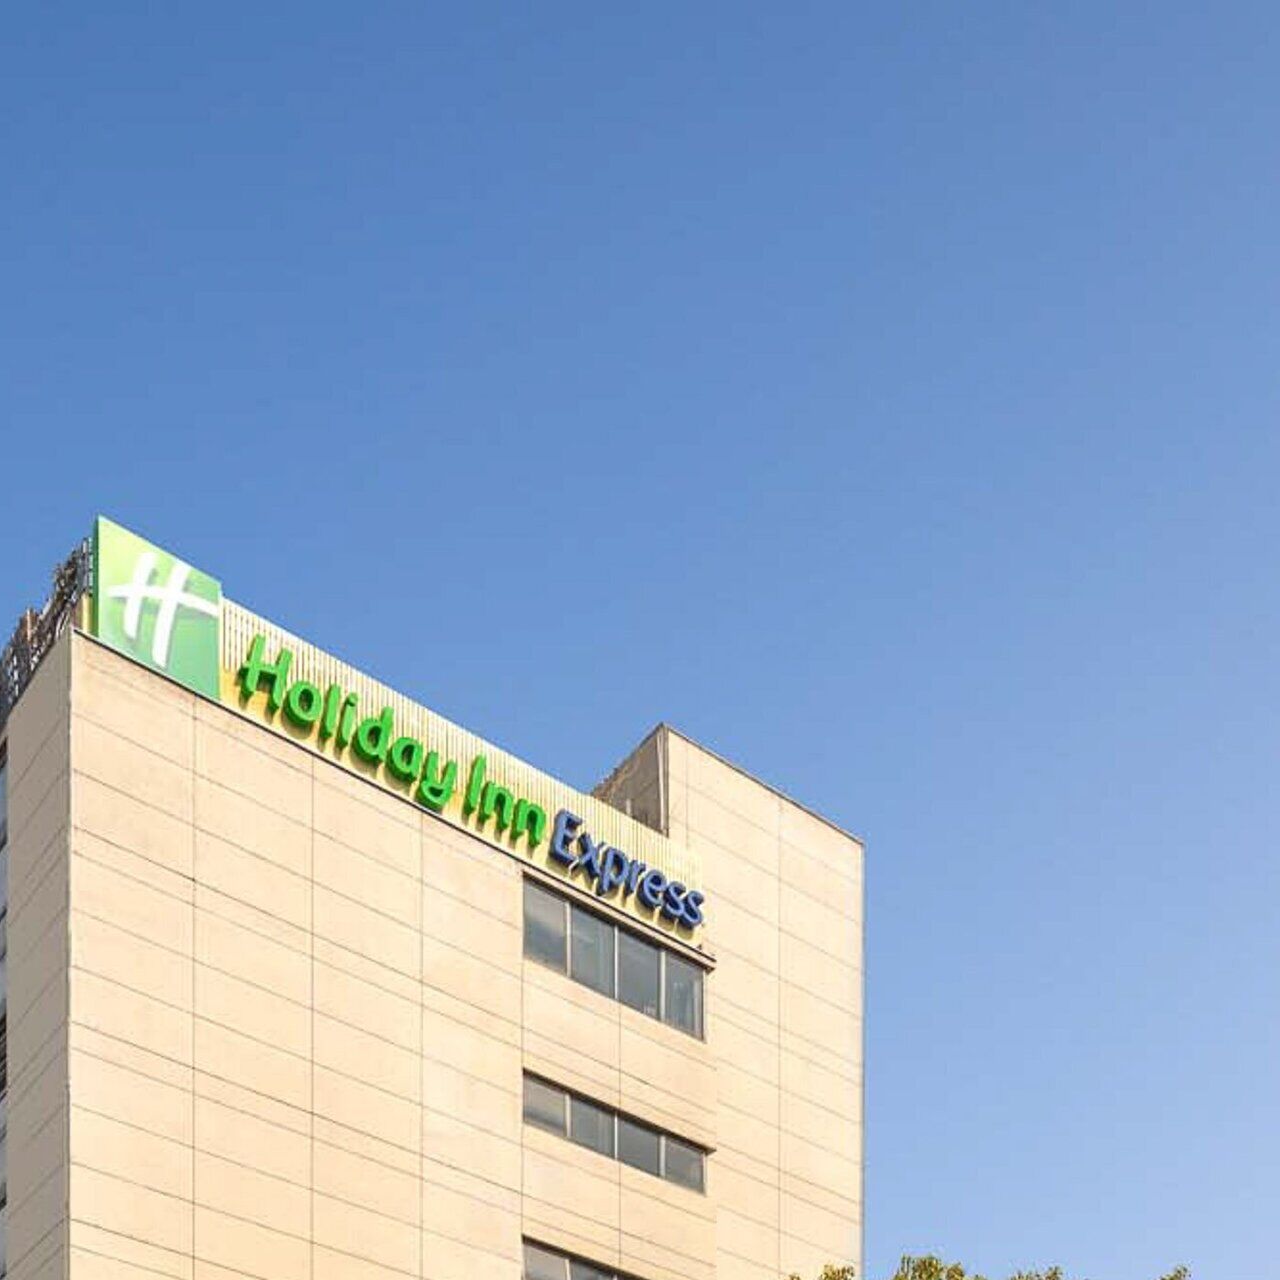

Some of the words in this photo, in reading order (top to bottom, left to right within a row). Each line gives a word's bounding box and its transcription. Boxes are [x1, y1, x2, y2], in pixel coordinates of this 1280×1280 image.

[239, 635, 457, 808] Holiday
[465, 754, 548, 847] Inn
[551, 809, 705, 929] Express
